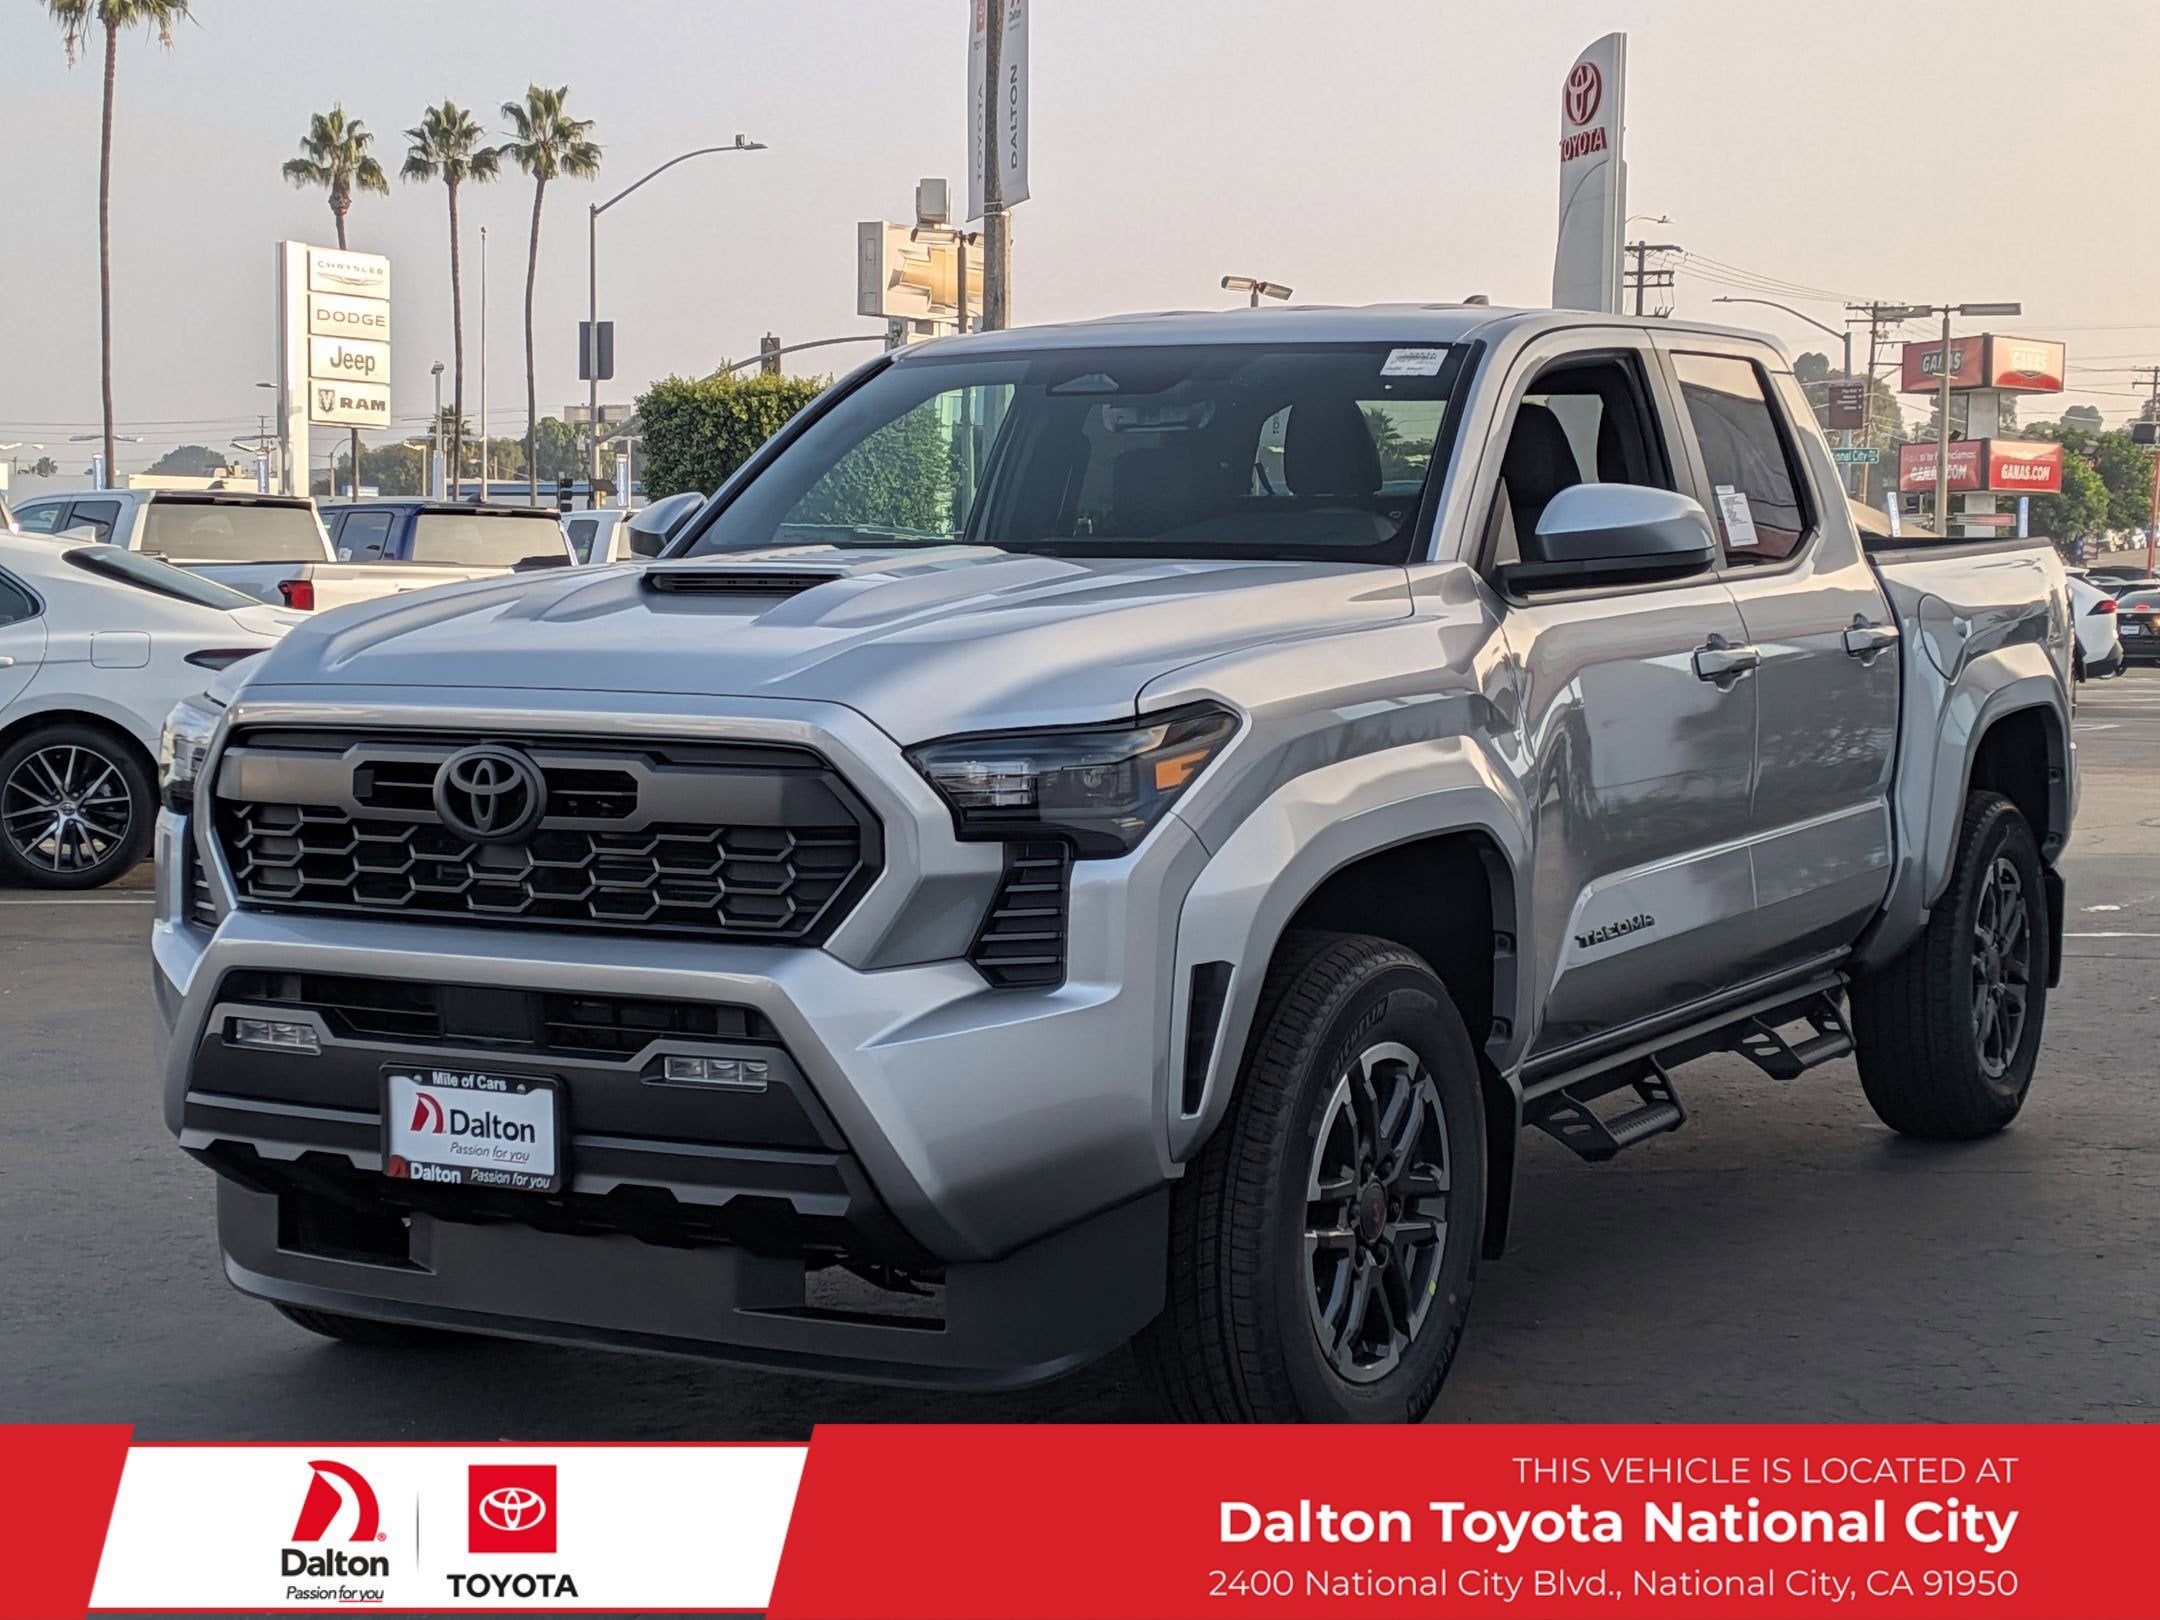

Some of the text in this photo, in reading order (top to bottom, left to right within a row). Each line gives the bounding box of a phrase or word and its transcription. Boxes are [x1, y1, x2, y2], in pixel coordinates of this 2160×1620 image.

[1010, 64, 1018, 169] DALTON
[1559, 126, 1608, 162] TOYOTA
[317, 260, 384, 276] CHRYSLER
[317, 308, 386, 327] DODGE
[330, 345, 376, 376] Jeep
[339, 396, 386, 412] RAM
[2001, 464, 2051, 481] GANAS.COM
[1574, 914, 1656, 949] TACOMA
[432, 1071, 507, 1091] Mile of Cars
[450, 1109, 535, 1143] Dalton
[450, 1142, 530, 1162] Passion for you
[410, 1162, 462, 1184] Dalton
[470, 1168, 551, 1189] Passion for you
